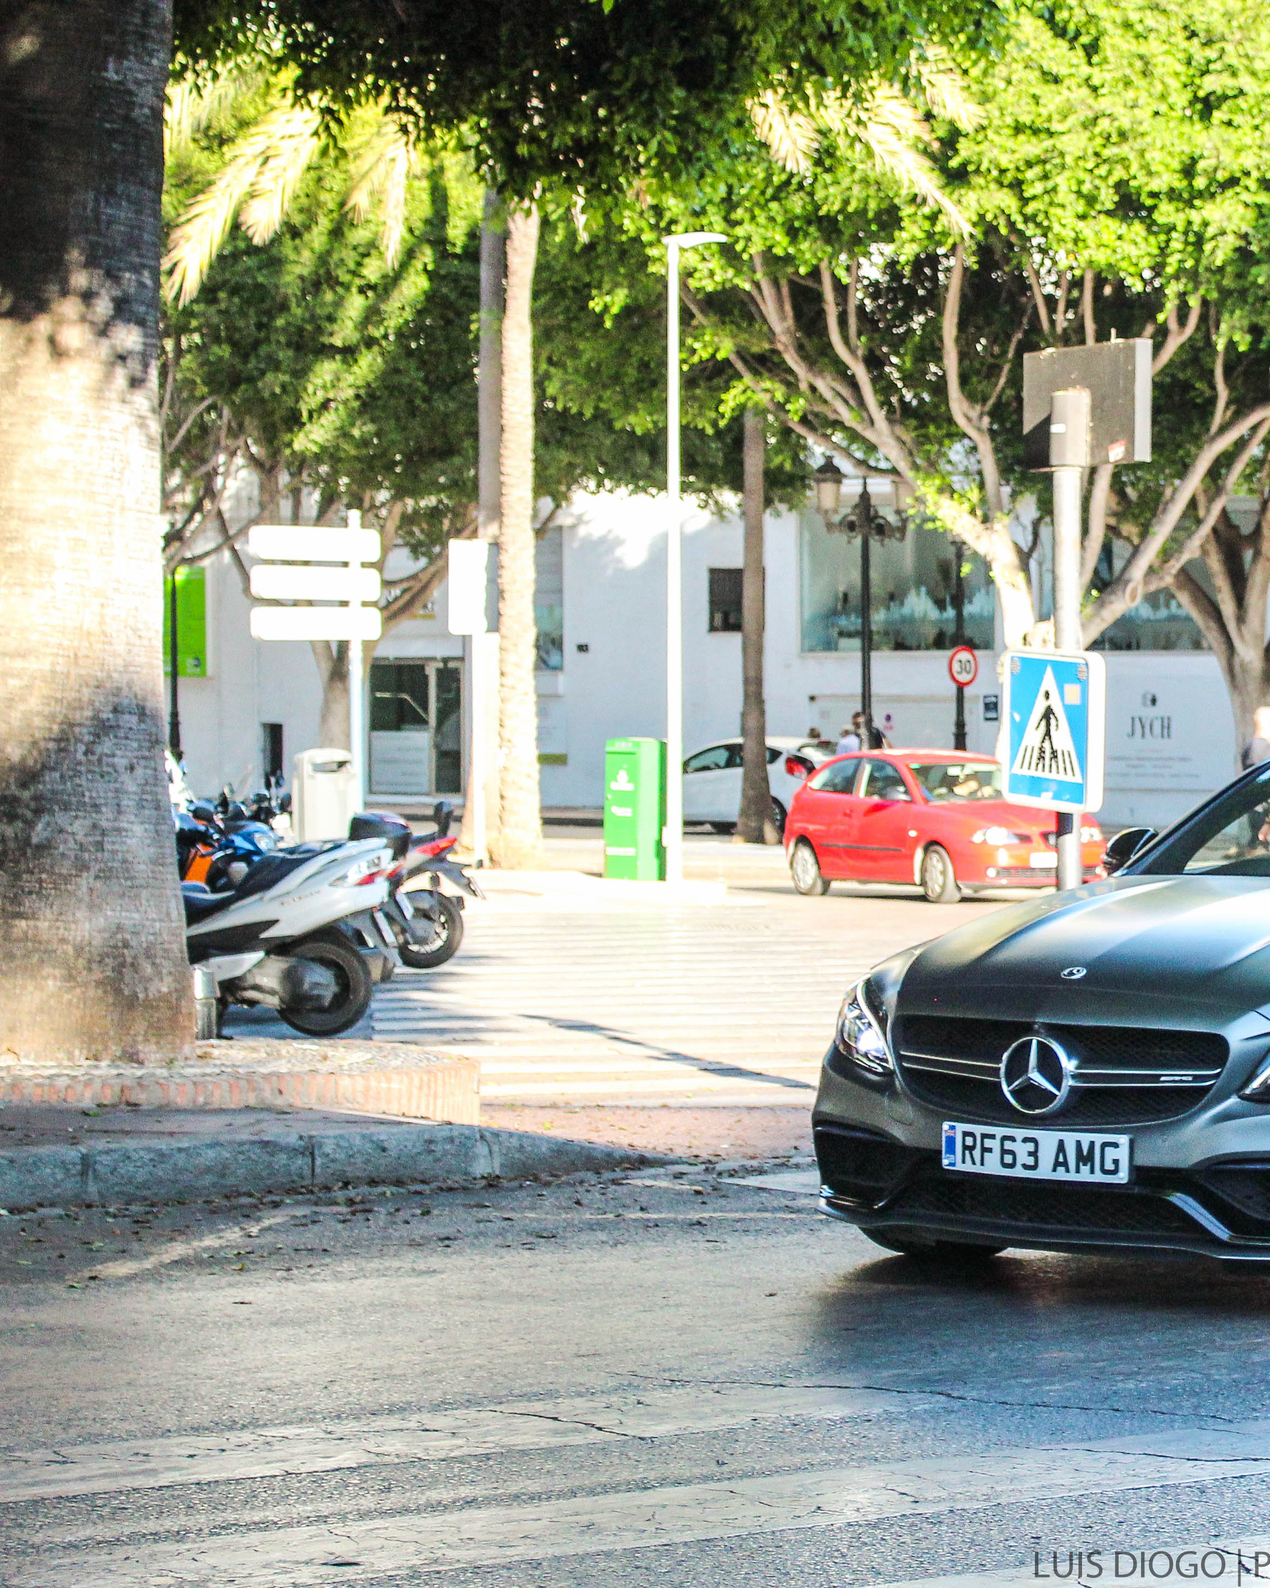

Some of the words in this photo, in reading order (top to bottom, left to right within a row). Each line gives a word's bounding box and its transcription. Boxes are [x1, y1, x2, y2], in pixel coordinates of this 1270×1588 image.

[956, 659, 972, 674] 30
[1127, 716, 1171, 739] JYCH
[961, 1131, 1039, 1171] RF63
[1051, 1139, 1120, 1175] AMG
